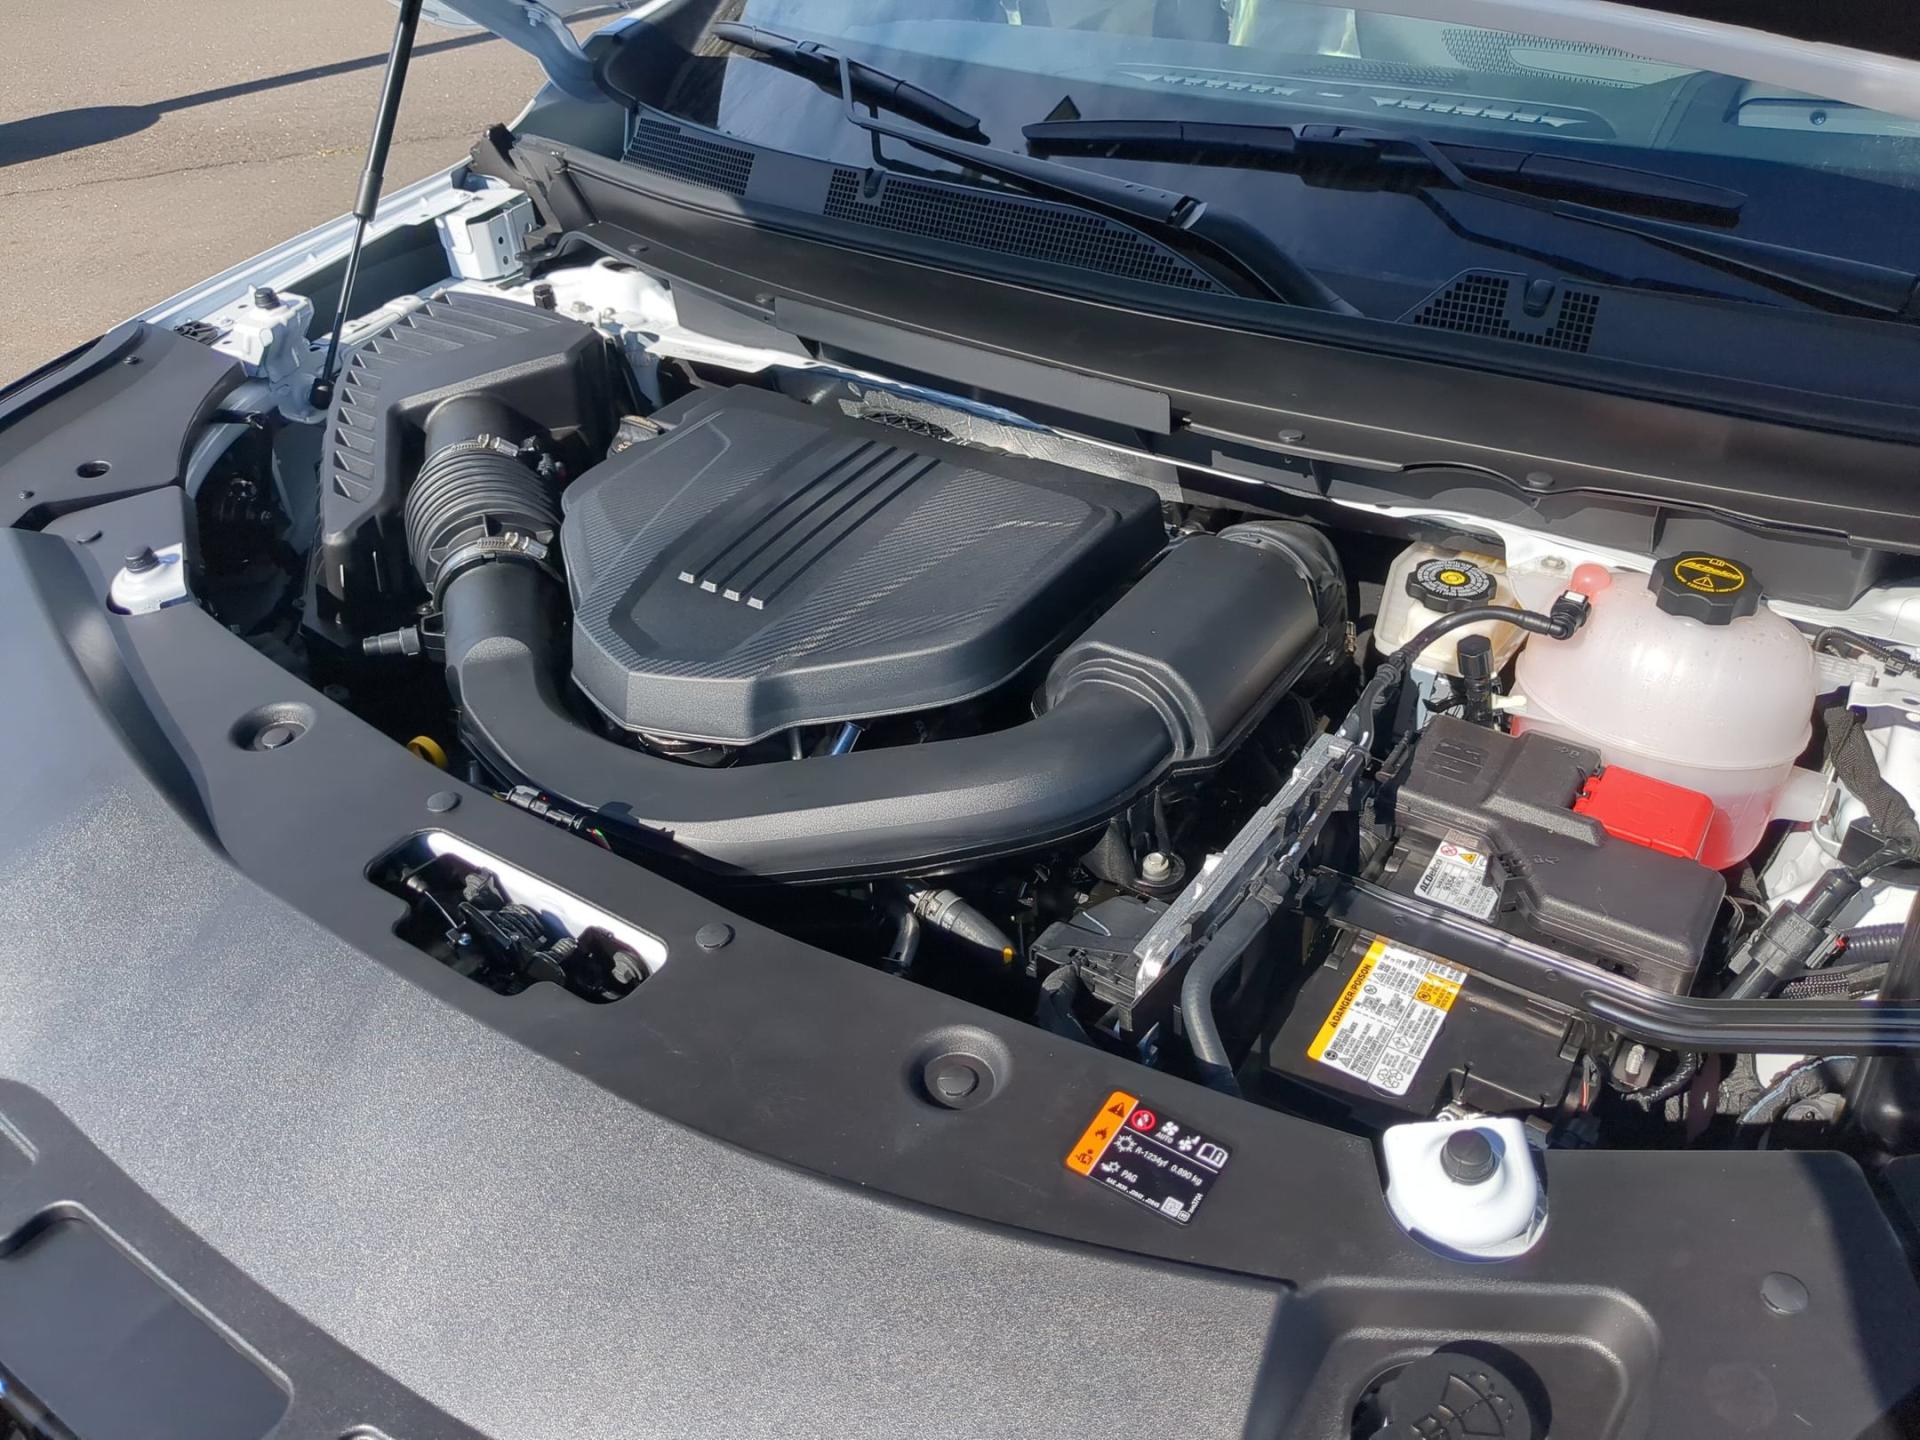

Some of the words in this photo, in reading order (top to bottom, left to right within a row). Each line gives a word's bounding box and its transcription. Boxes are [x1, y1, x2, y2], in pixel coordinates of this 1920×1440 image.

[1680, 562, 1741, 580] ACDelco
[1419, 858, 1443, 892] ACDelco
[1155, 1131, 1174, 1144] AUTO
[1134, 1146, 1170, 1168] R-1234yf
[1191, 1174, 1203, 1187] kg
[1120, 1169, 1139, 1183] PAG
